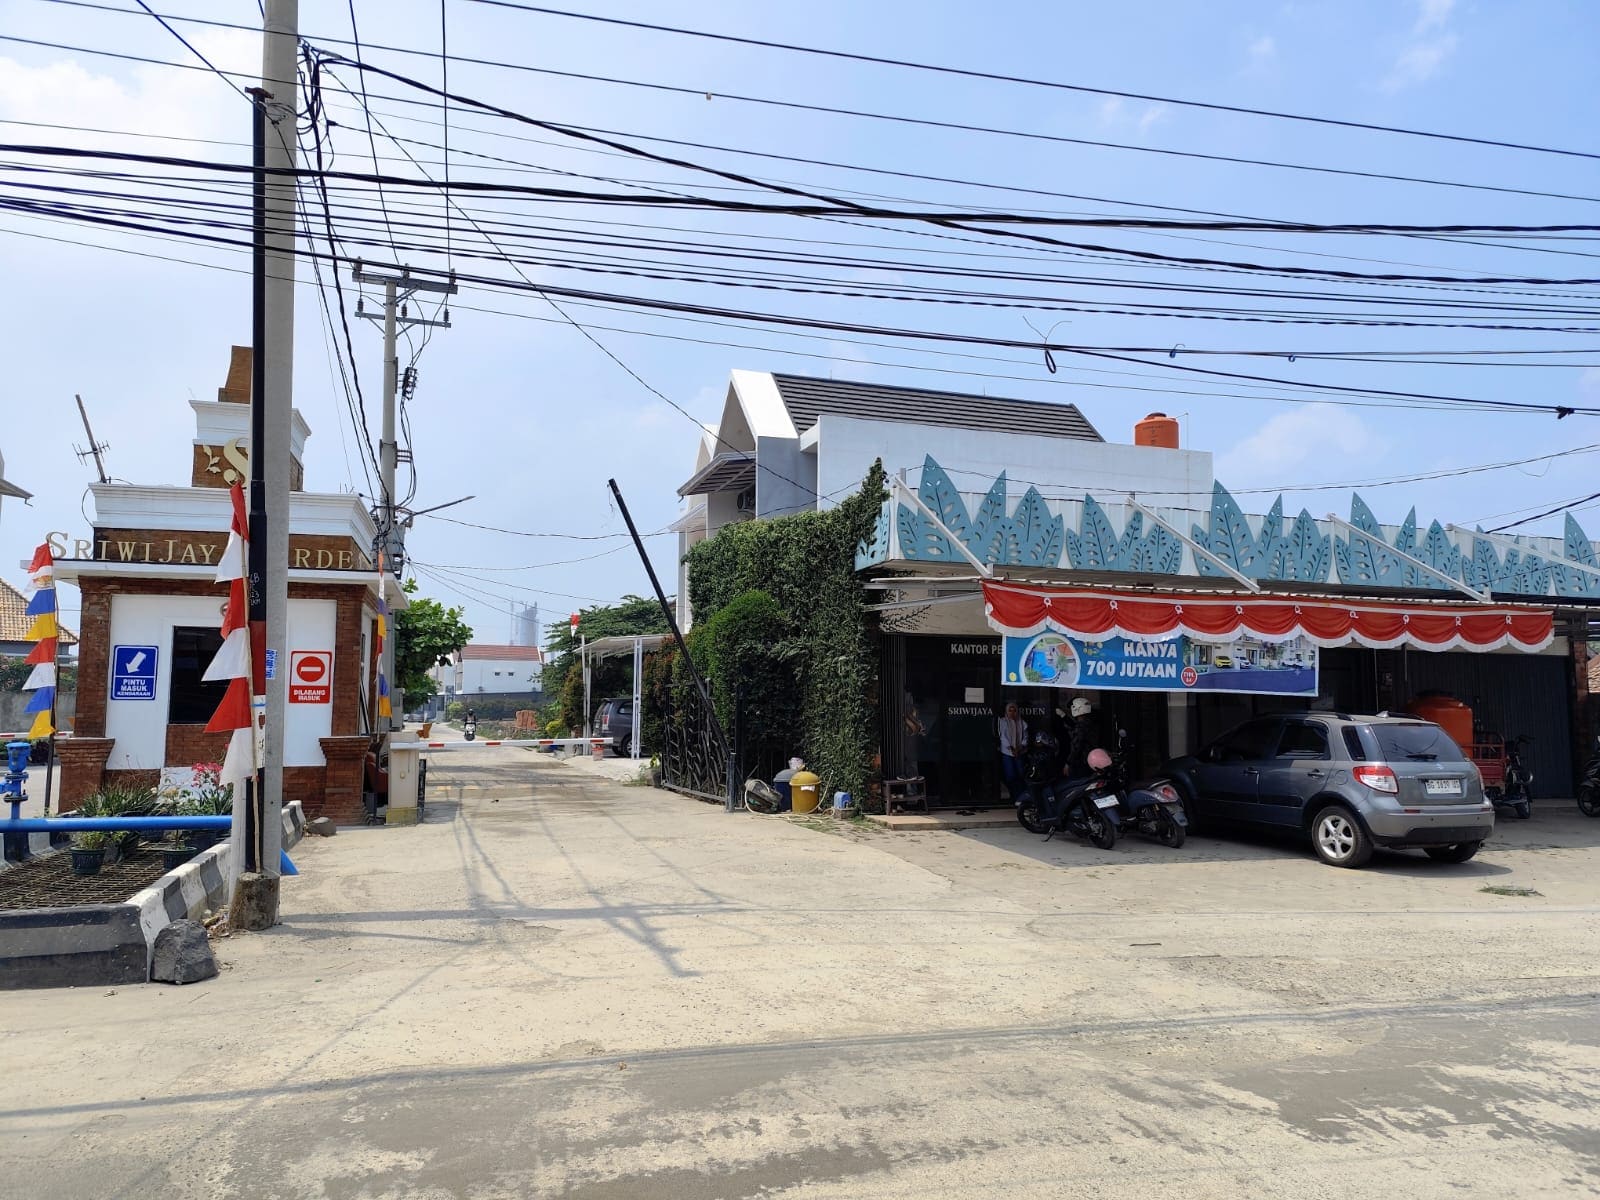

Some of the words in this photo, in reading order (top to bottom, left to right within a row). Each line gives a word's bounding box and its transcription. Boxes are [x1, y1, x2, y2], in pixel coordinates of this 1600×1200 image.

[47, 532, 217, 565] SRIWIJAY
[293, 548, 373, 570] RDEN
[951, 643, 989, 655] KANTOR
[1123, 641, 1178, 658] HANYA
[1086, 660, 1116, 677] 700
[1119, 661, 1177, 678] JUTAAN
[948, 707, 993, 716] SRIWIJAYA
[1020, 707, 1046, 715] RDEN
